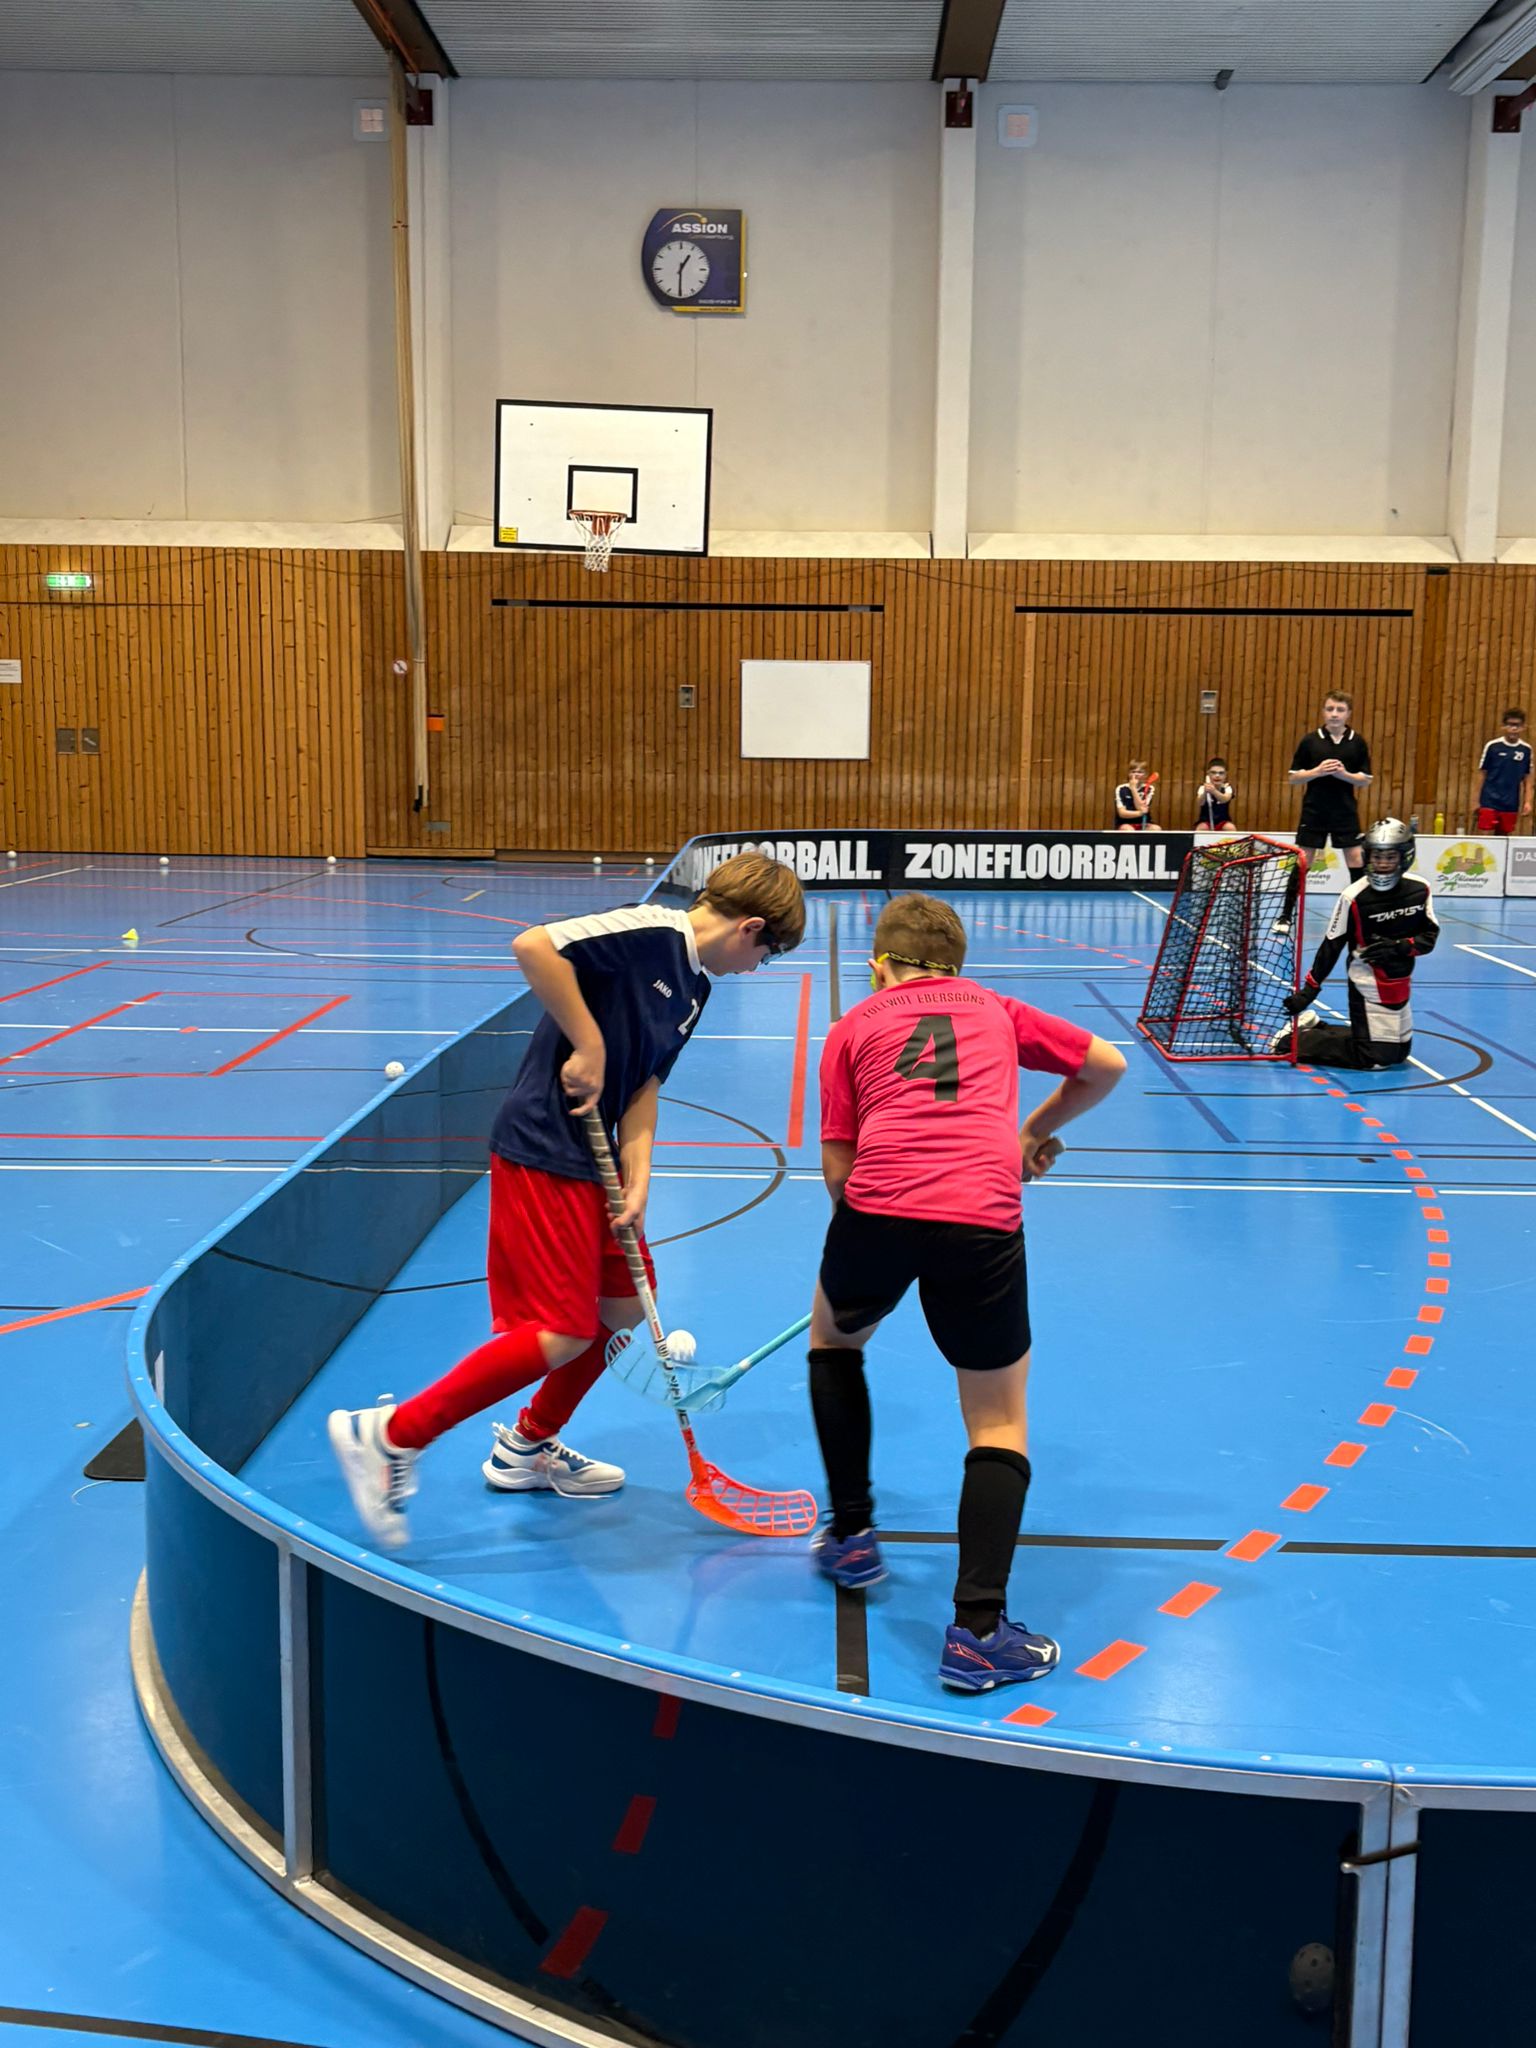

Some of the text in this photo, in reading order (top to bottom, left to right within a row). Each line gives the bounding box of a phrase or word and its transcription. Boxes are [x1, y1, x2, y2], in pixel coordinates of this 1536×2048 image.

[672, 223, 728, 234] ASSION
[904, 843, 1179, 880] ZONEFLOORBALL.
[653, 979, 672, 998] JAKO
[862, 994, 911, 1019] TOLLWUT
[893, 1014, 959, 1103] 4
